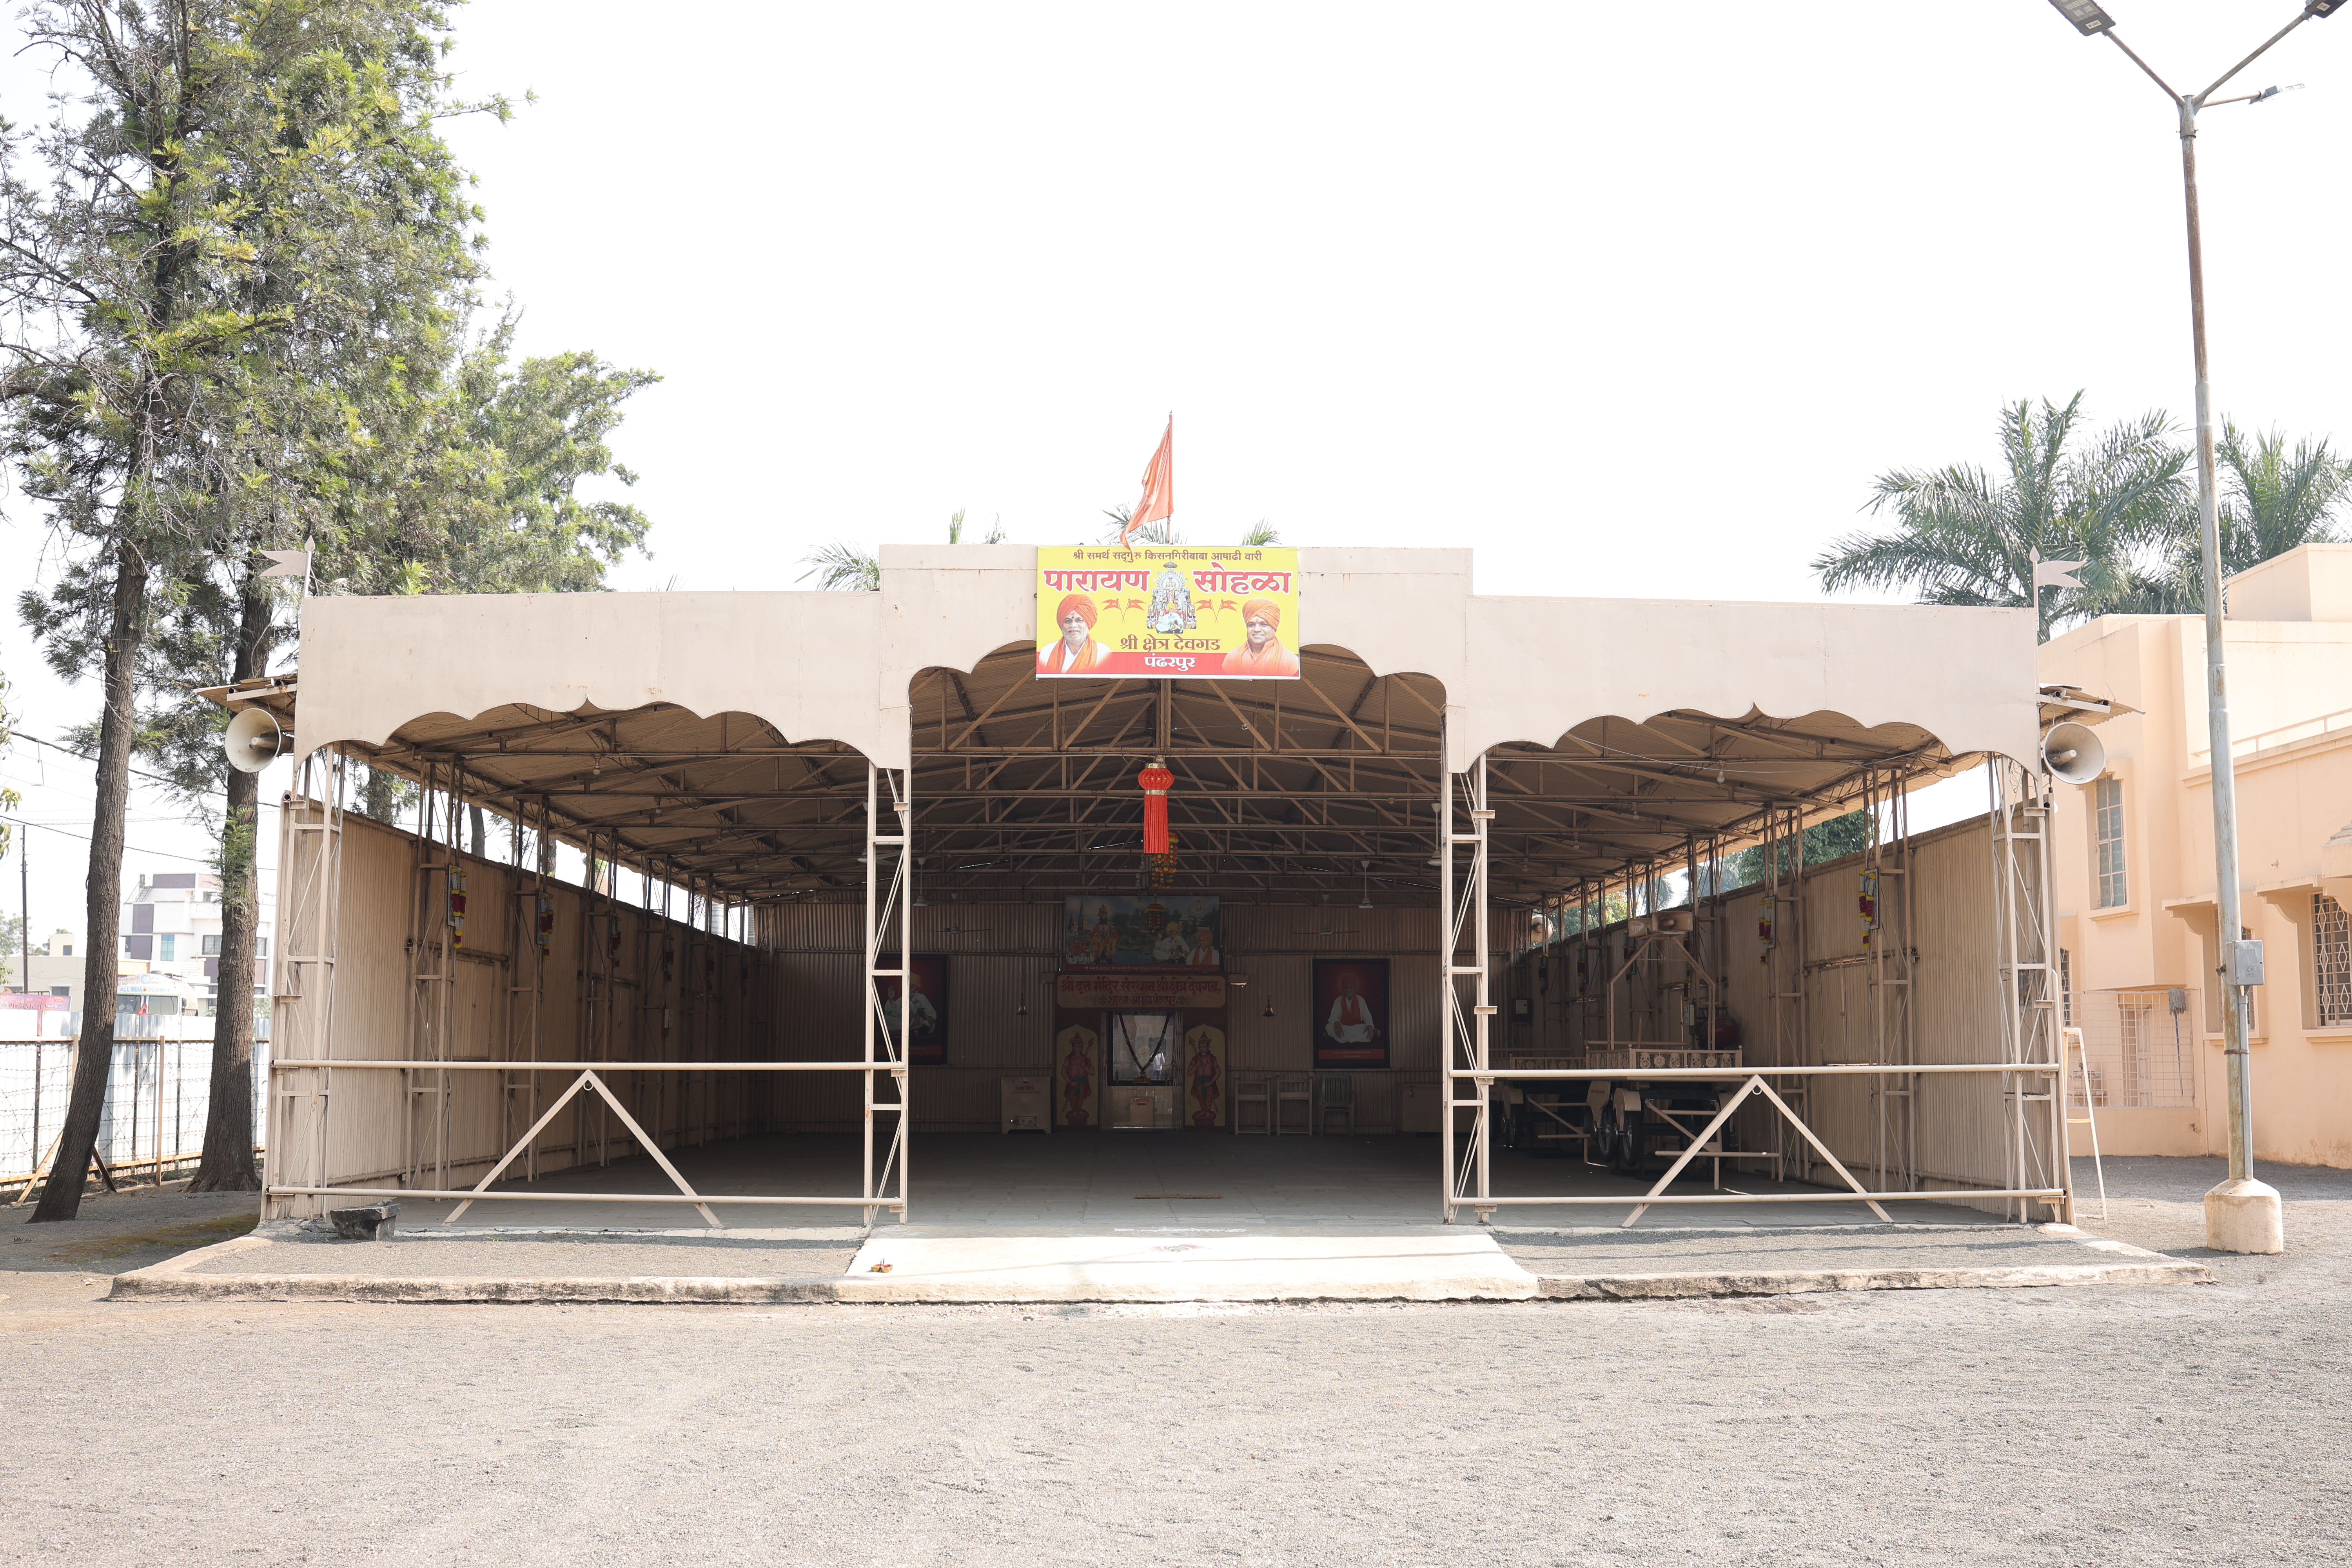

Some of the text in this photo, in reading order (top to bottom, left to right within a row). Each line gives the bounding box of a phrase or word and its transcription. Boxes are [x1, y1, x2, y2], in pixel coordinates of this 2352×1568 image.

[1073, 549, 1083, 559] श्री
[1087, 549, 1110, 559] समर्थ
[1145, 550, 1208, 560] किसनगिरीबाबा
[1211, 550, 1241, 560] आषाढी
[1245, 550, 1262, 561] वारी
[1043, 570, 1150, 592] पारायण
[1193, 561, 1292, 595] सोहळा
[1120, 634, 1221, 652] श्री क्षेत्र देवगड
[1144, 653, 1196, 671] पंढरपुर
[1060, 976, 1221, 995] श्री दत्त मंदिर संस्थान श्री क्षेत्र देवगड,
[1141, 993, 1152, 1006] क्षेत्र
